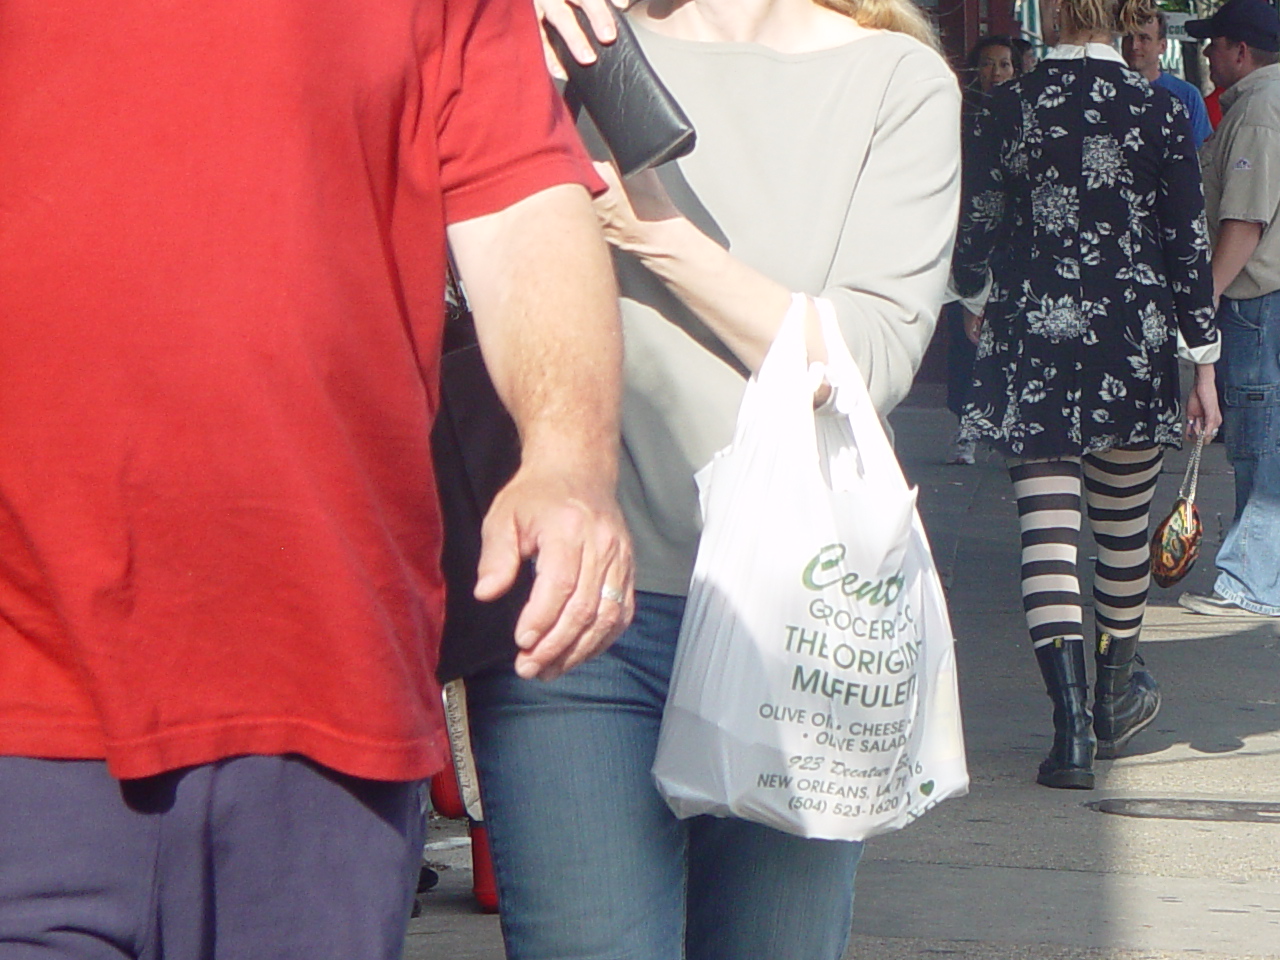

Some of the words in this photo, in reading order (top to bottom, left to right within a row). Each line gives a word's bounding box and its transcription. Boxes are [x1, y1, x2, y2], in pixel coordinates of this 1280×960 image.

[759, 703, 806, 724] OLIVE
[849, 719, 906, 737] CHEESE
[859, 733, 908, 753] SALAD
[788, 755, 825, 771] 923
[830, 760, 890, 778] Decatur
[757, 774, 793, 789] NEW
[788, 796, 827, 814] (504)
[832, 796, 898, 817] 523-1620
